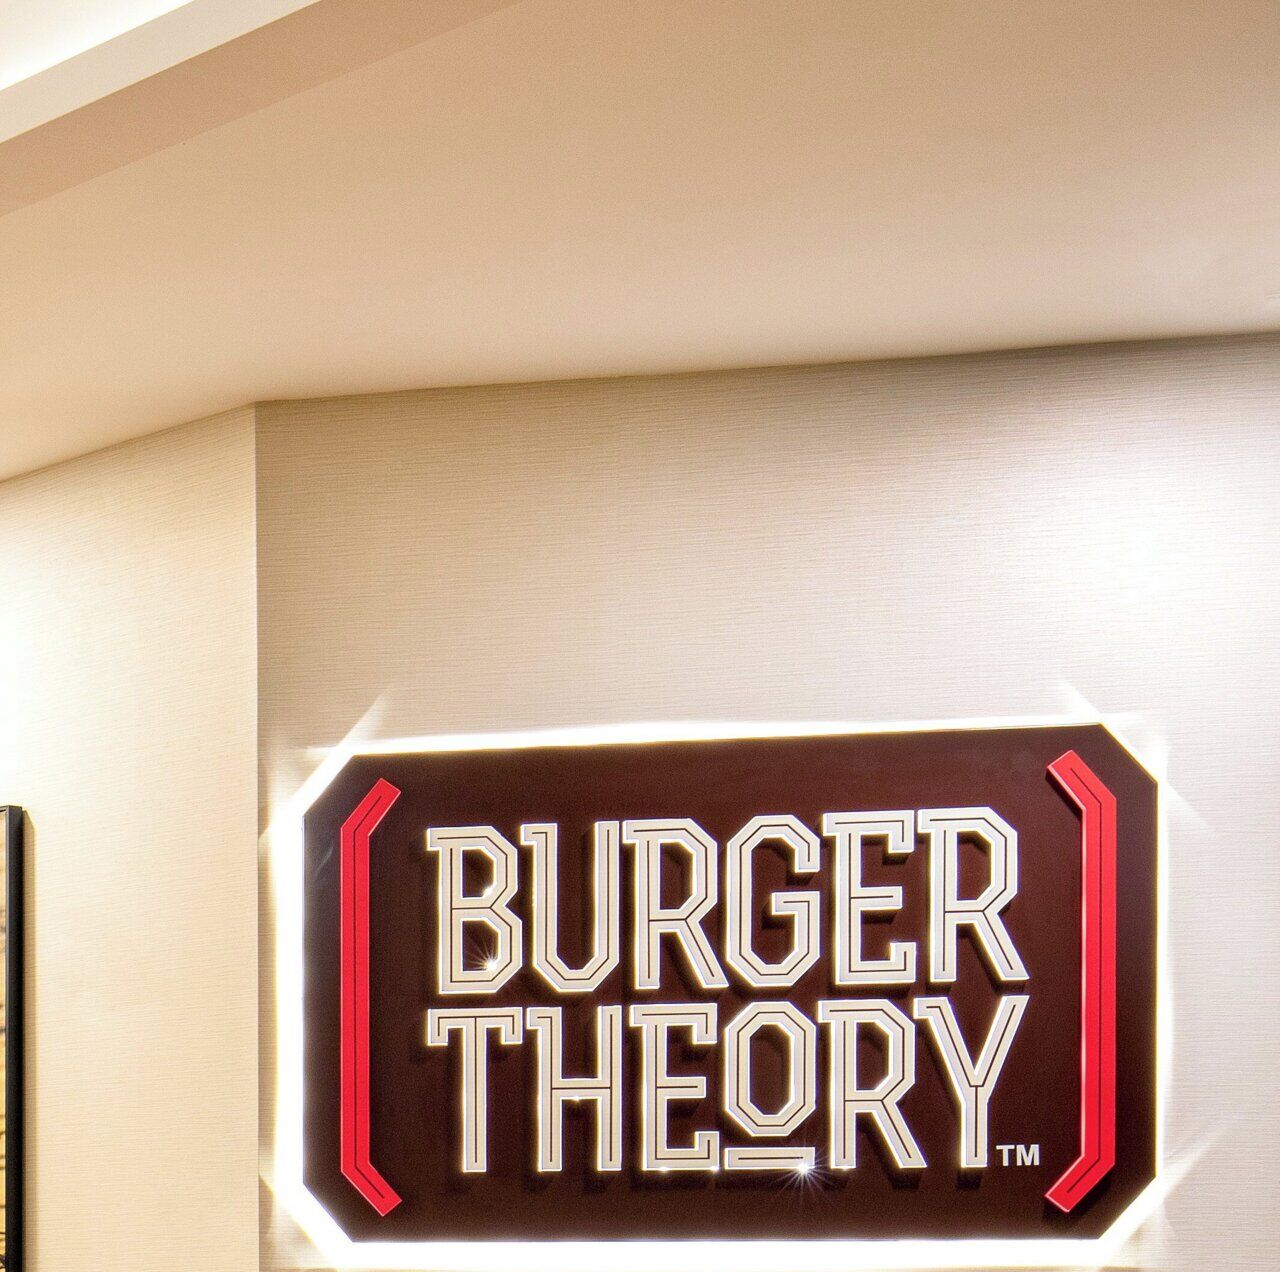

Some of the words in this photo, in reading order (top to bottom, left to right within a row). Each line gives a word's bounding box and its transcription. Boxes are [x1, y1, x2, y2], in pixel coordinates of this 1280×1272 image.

[427, 806, 1030, 996] BURGER
[427, 995, 1030, 1174] THEORY
[996, 1144, 1041, 1167] TM
